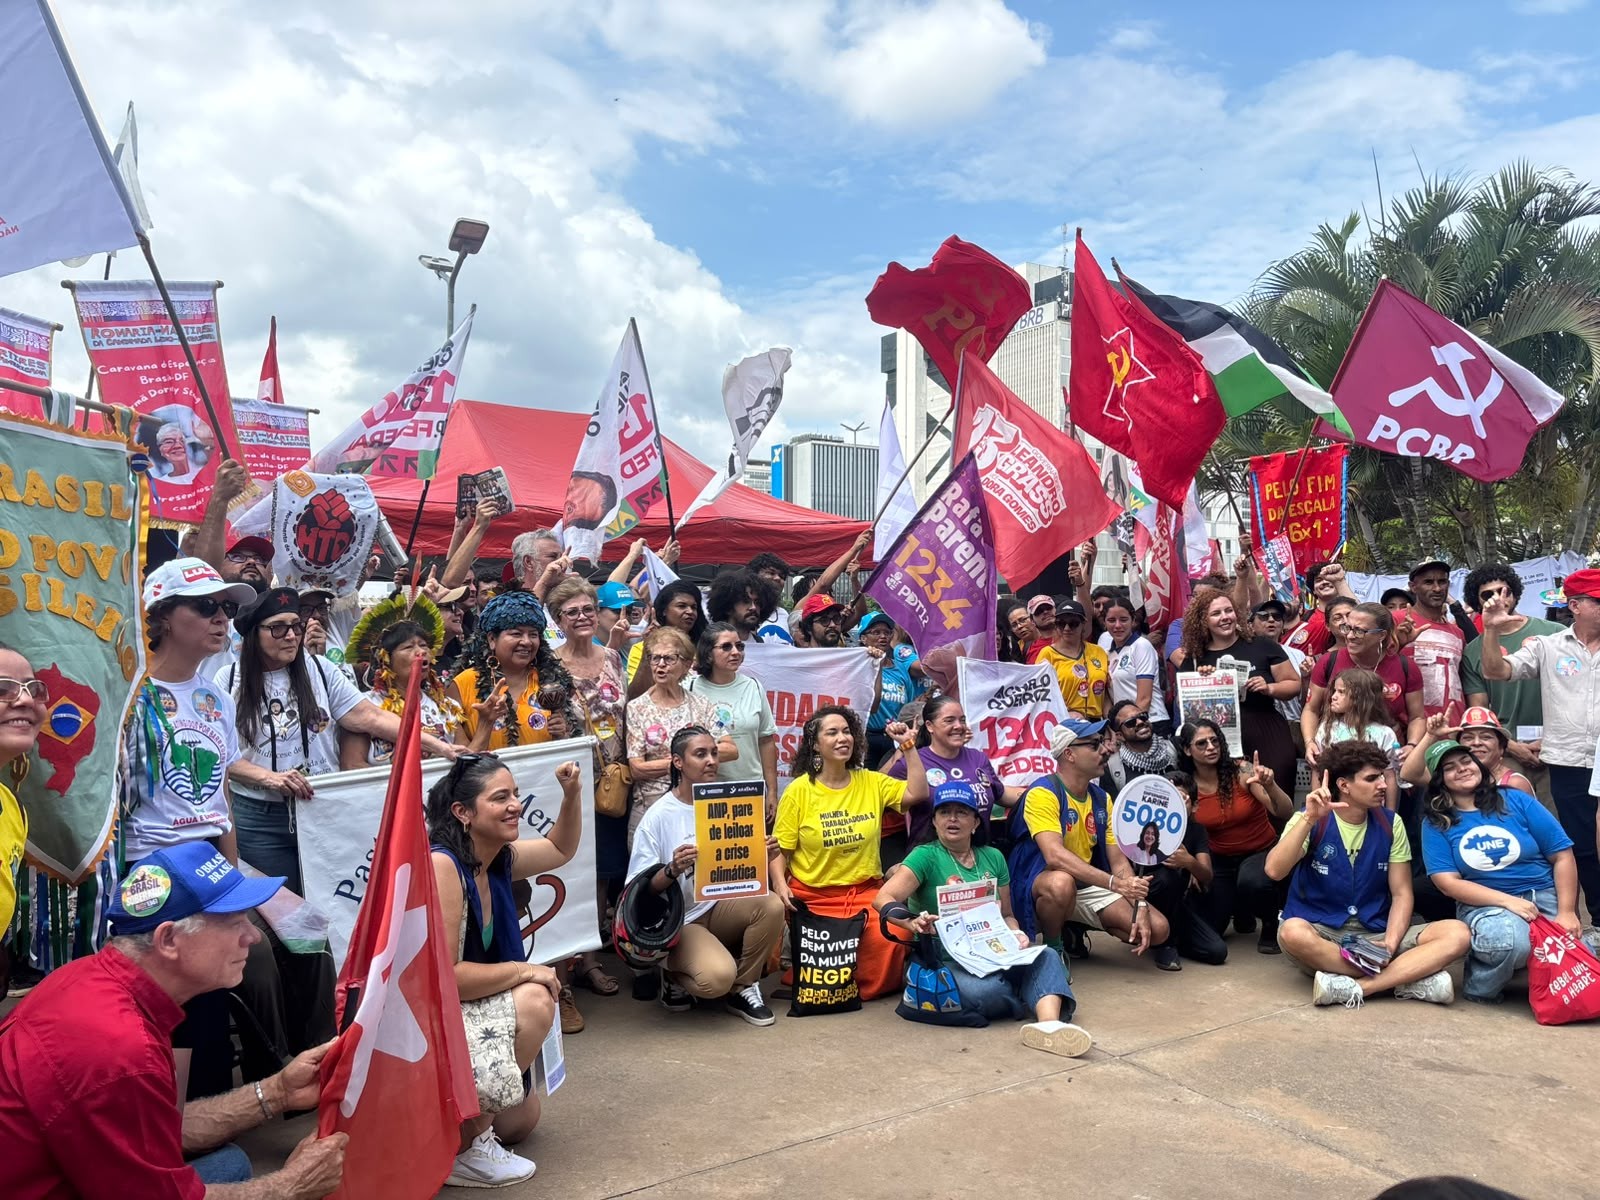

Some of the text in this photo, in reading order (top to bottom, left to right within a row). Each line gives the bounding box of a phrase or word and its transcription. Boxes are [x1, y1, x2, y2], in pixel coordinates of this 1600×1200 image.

[1019, 306, 1044, 330] BRB
[97, 364, 158, 375] Caravana
[996, 453, 1054, 523] GRASS
[1012, 445, 1061, 513] LEANDRO
[1265, 474, 1336, 501] PELO FIM
[940, 479, 983, 538] Rafa
[982, 476, 1005, 498] DORA
[1002, 493, 1036, 532] GOMES
[1267, 496, 1336, 521] DA ESCALA
[1289, 519, 1323, 543] 6x1
[297, 524, 351, 564] MTD
[893, 533, 974, 631] 1234
[897, 585, 930, 628] PDT12
[980, 711, 1058, 760] 1310
[1141, 795, 1169, 808] KARINE
[707, 802, 754, 821] ANP, pare
[819, 810, 844, 820] MULHER
[1121, 799, 1183, 834] 5080
[821, 815, 870, 828] TRABALHADORA
[709, 822, 754, 841] de leiloar
[822, 829, 832, 838] DE
[832, 828, 848, 836] LUTA
[823, 833, 866, 848] NA POLÍTICA.
[715, 843, 750, 861] a crise
[1476, 838, 1506, 851] UNE
[710, 865, 758, 883] climática
[130, 878, 160, 896] BRASIL
[947, 889, 977, 902] VERDADE
[801, 925, 831, 941] PELO
[965, 920, 991, 933] GRITO
[800, 937, 825, 953] BEM
[800, 952, 816, 966] DA
